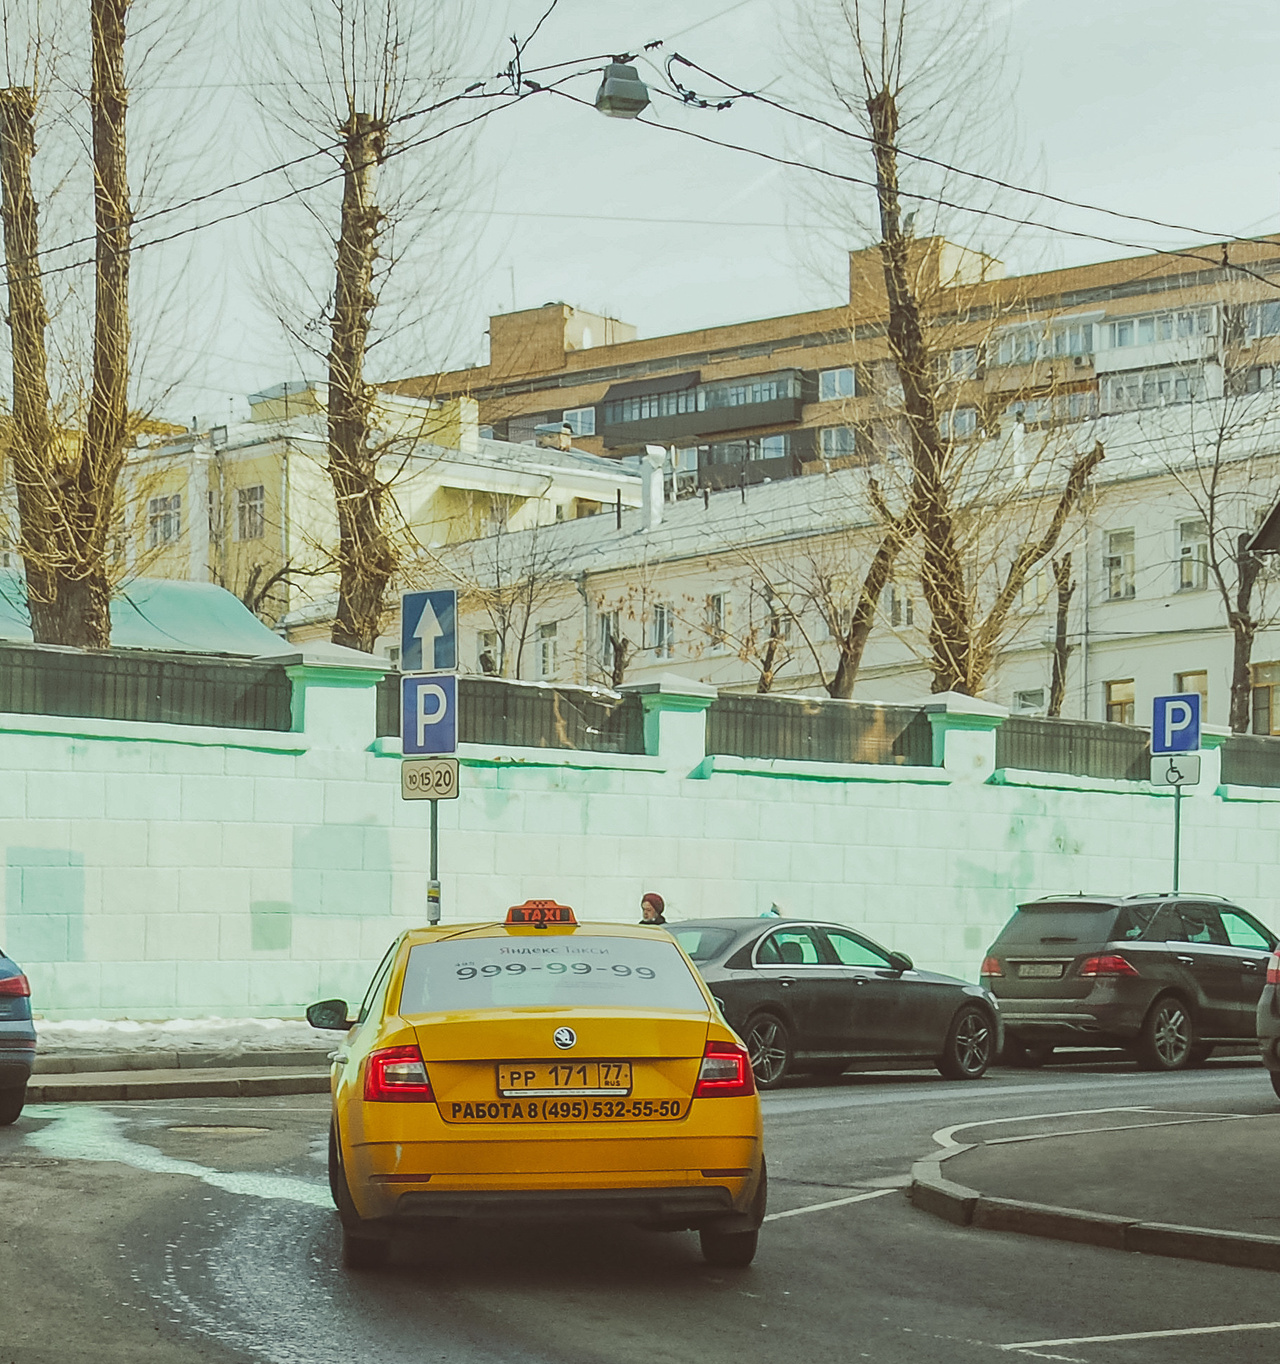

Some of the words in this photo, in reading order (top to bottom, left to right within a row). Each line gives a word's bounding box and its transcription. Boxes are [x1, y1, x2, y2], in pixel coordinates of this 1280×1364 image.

[417, 684, 447, 746] P
[1164, 700, 1192, 747] P
[408, 774, 417, 784] 10
[420, 772, 431, 786] 15
[434, 770, 451, 787] 20
[521, 909, 561, 921] TAXI
[499, 946, 559, 955] Яндекс
[565, 947, 609, 955] Такси
[456, 962, 656, 981] 999-99-99
[548, 1066, 588, 1086] 171
[601, 1064, 623, 1080] 77
[452, 1103, 524, 1119] РАБОТА
[527, 1103, 538, 1117] 8
[542, 1101, 588, 1120] (495)
[592, 1101, 680, 1117] 532-55-50
